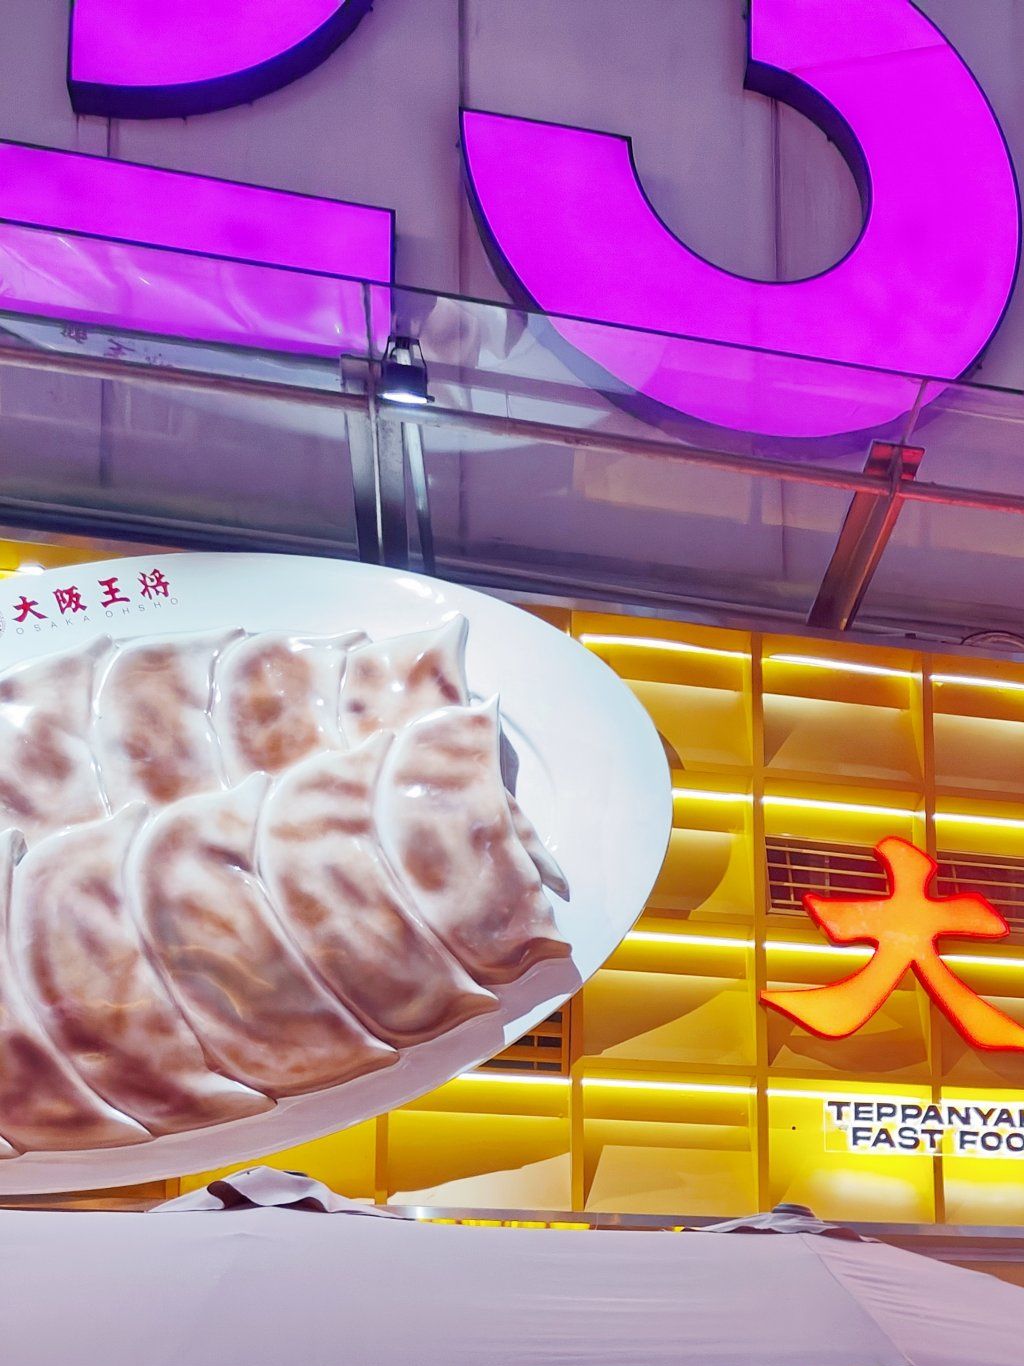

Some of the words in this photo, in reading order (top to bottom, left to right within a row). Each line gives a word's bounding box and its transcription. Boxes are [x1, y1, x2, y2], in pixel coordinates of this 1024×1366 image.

[12, 568, 171, 623] 大阪王将
[15, 614, 92, 635] OSAKA
[104, 597, 179, 618] OHSHO
[851, 1126, 944, 1149] FAST
